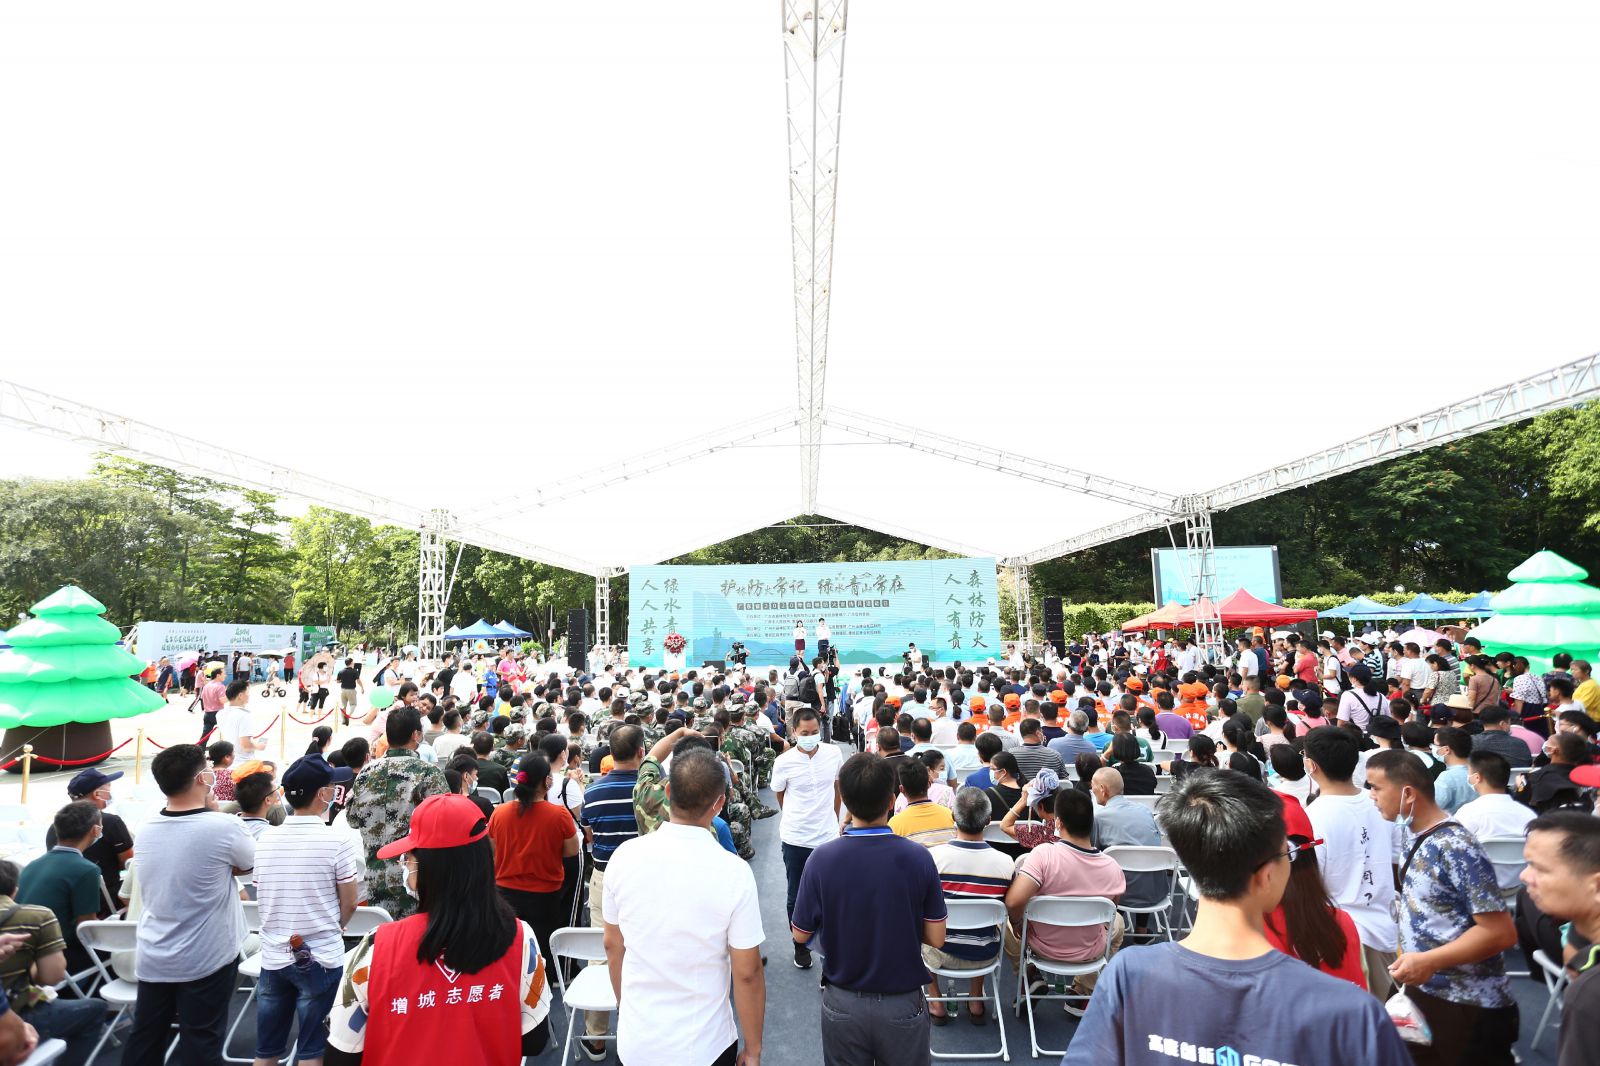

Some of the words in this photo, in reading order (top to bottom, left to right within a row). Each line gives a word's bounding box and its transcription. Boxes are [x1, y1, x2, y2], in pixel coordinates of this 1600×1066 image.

[641, 579, 659, 656] 人人共享
[663, 578, 682, 635] 绿水青
[945, 573, 963, 650] 人人有责
[967, 569, 989, 648] 森林防火
[391, 983, 504, 1015] 增城志愿者
